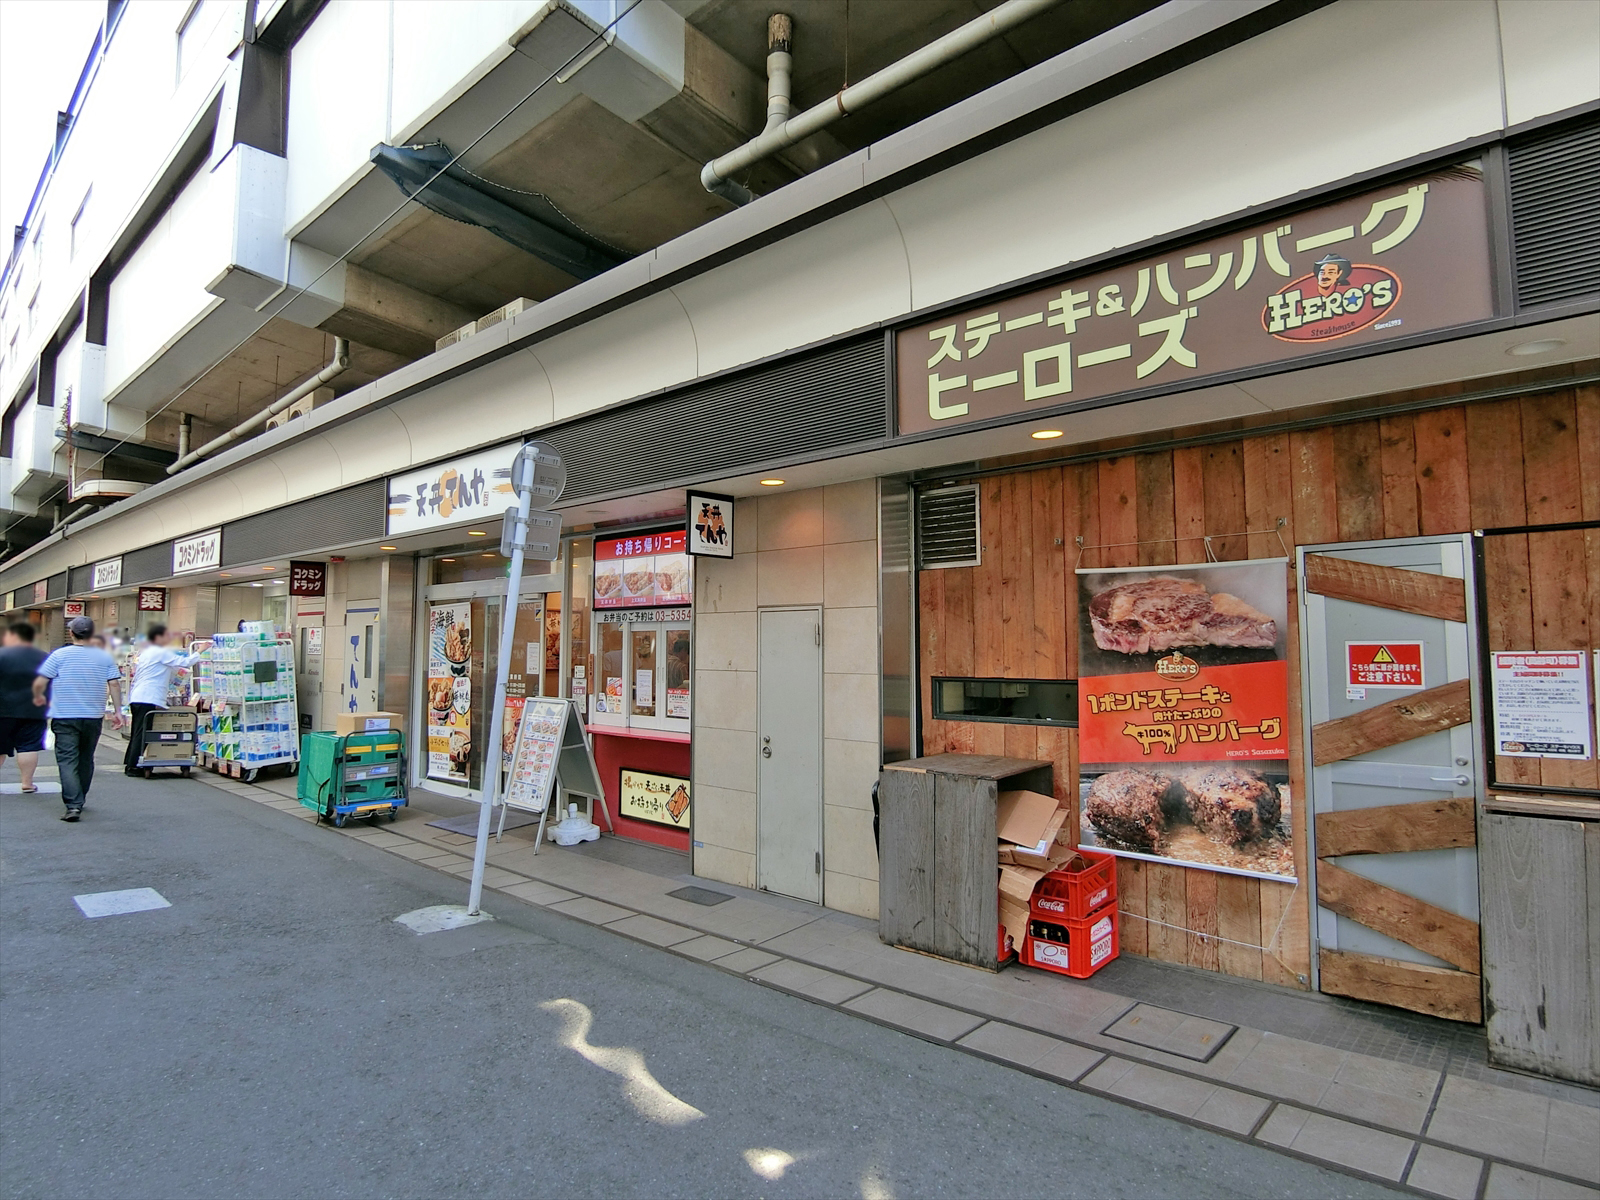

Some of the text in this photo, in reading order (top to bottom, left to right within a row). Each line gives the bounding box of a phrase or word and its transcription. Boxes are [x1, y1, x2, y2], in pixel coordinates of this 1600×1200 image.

[928, 183, 1429, 369] ステーキ&ハンバーグ
[1268, 279, 1393, 334] HERO'S
[1310, 320, 1356, 337] Steakhouse
[928, 307, 1198, 421] ヒーローズ
[701, 502, 722, 520] 天丼
[695, 523, 727, 545] てんや
[178, 538, 216, 568] コクミンドラッグ
[294, 568, 322, 580] コクミン
[293, 580, 322, 591] ドラッグ
[141, 590, 163, 609] 薬
[603, 611, 654, 622] お弁当のご予約は
[348, 634, 360, 713] てんや
[1157, 659, 1197, 674] HERO'S
[1358, 671, 1415, 683] ご注意下さい。
[1087, 685, 1232, 714] 1ポンドステーキと
[1153, 707, 1222, 722] 肉汁たっぷりの
[1178, 717, 1281, 744] ハンバーグ
[1225, 748, 1285, 757] HERO'S Sasazuka
